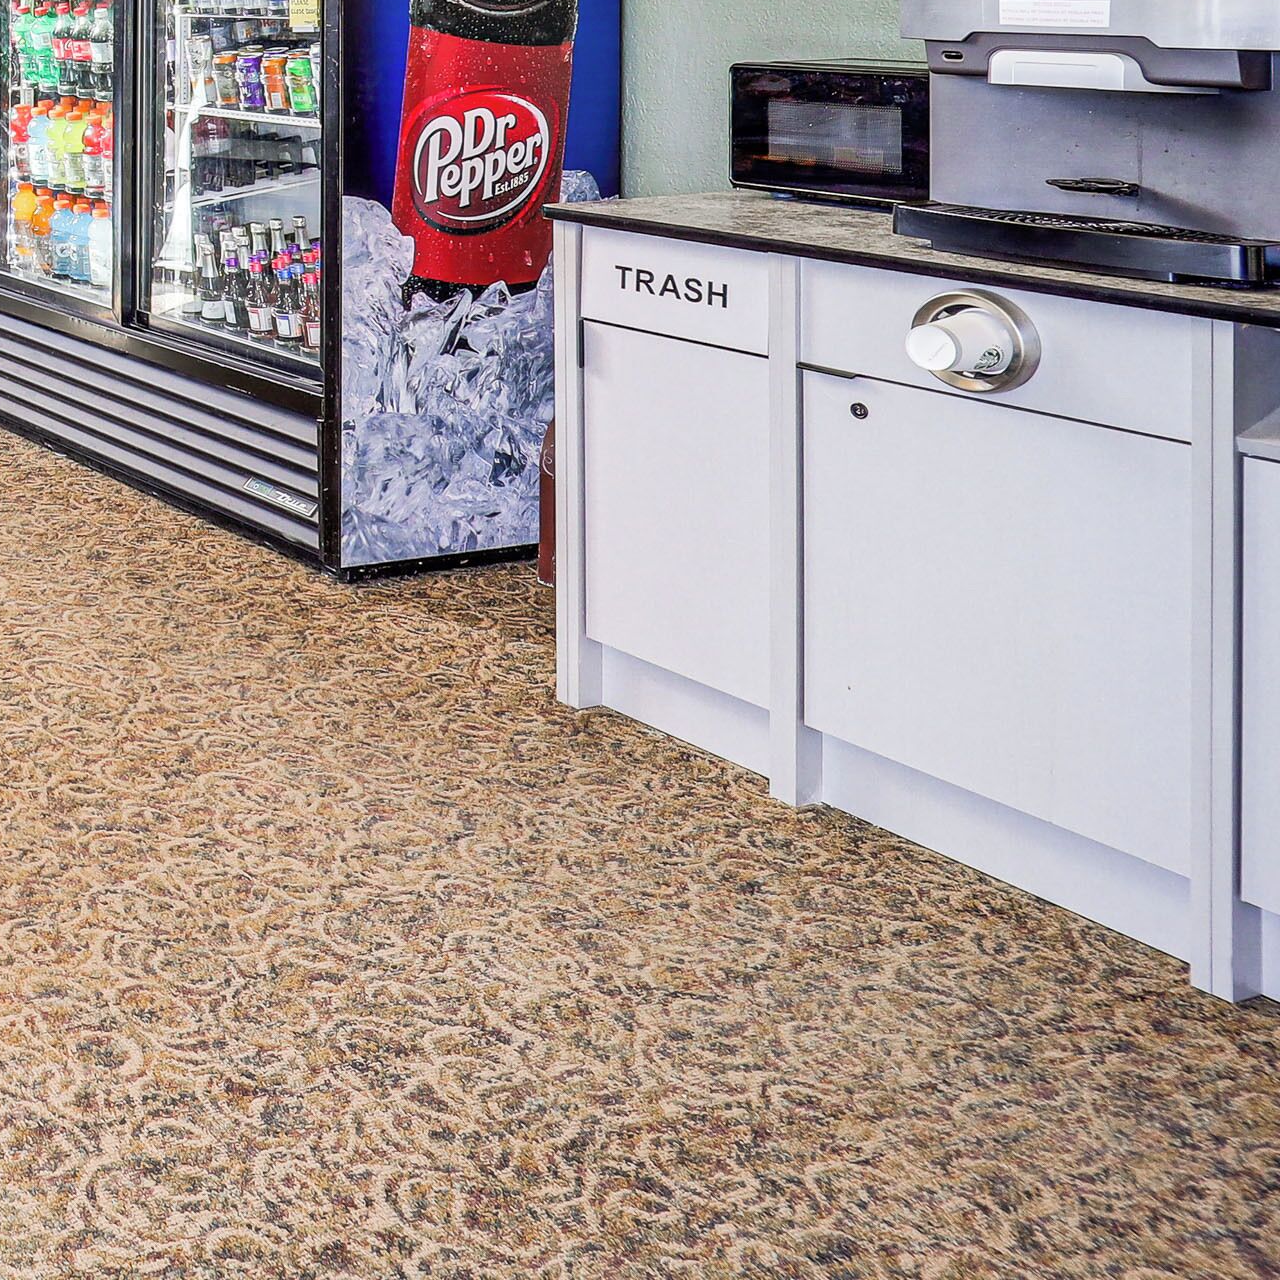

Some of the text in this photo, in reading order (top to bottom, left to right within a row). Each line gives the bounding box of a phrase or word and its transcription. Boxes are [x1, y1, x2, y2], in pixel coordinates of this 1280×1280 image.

[461, 107, 517, 161] Dr
[413, 115, 542, 208] Pepper
[494, 172, 530, 196] Est.1885
[615, 264, 729, 308] TRASH
